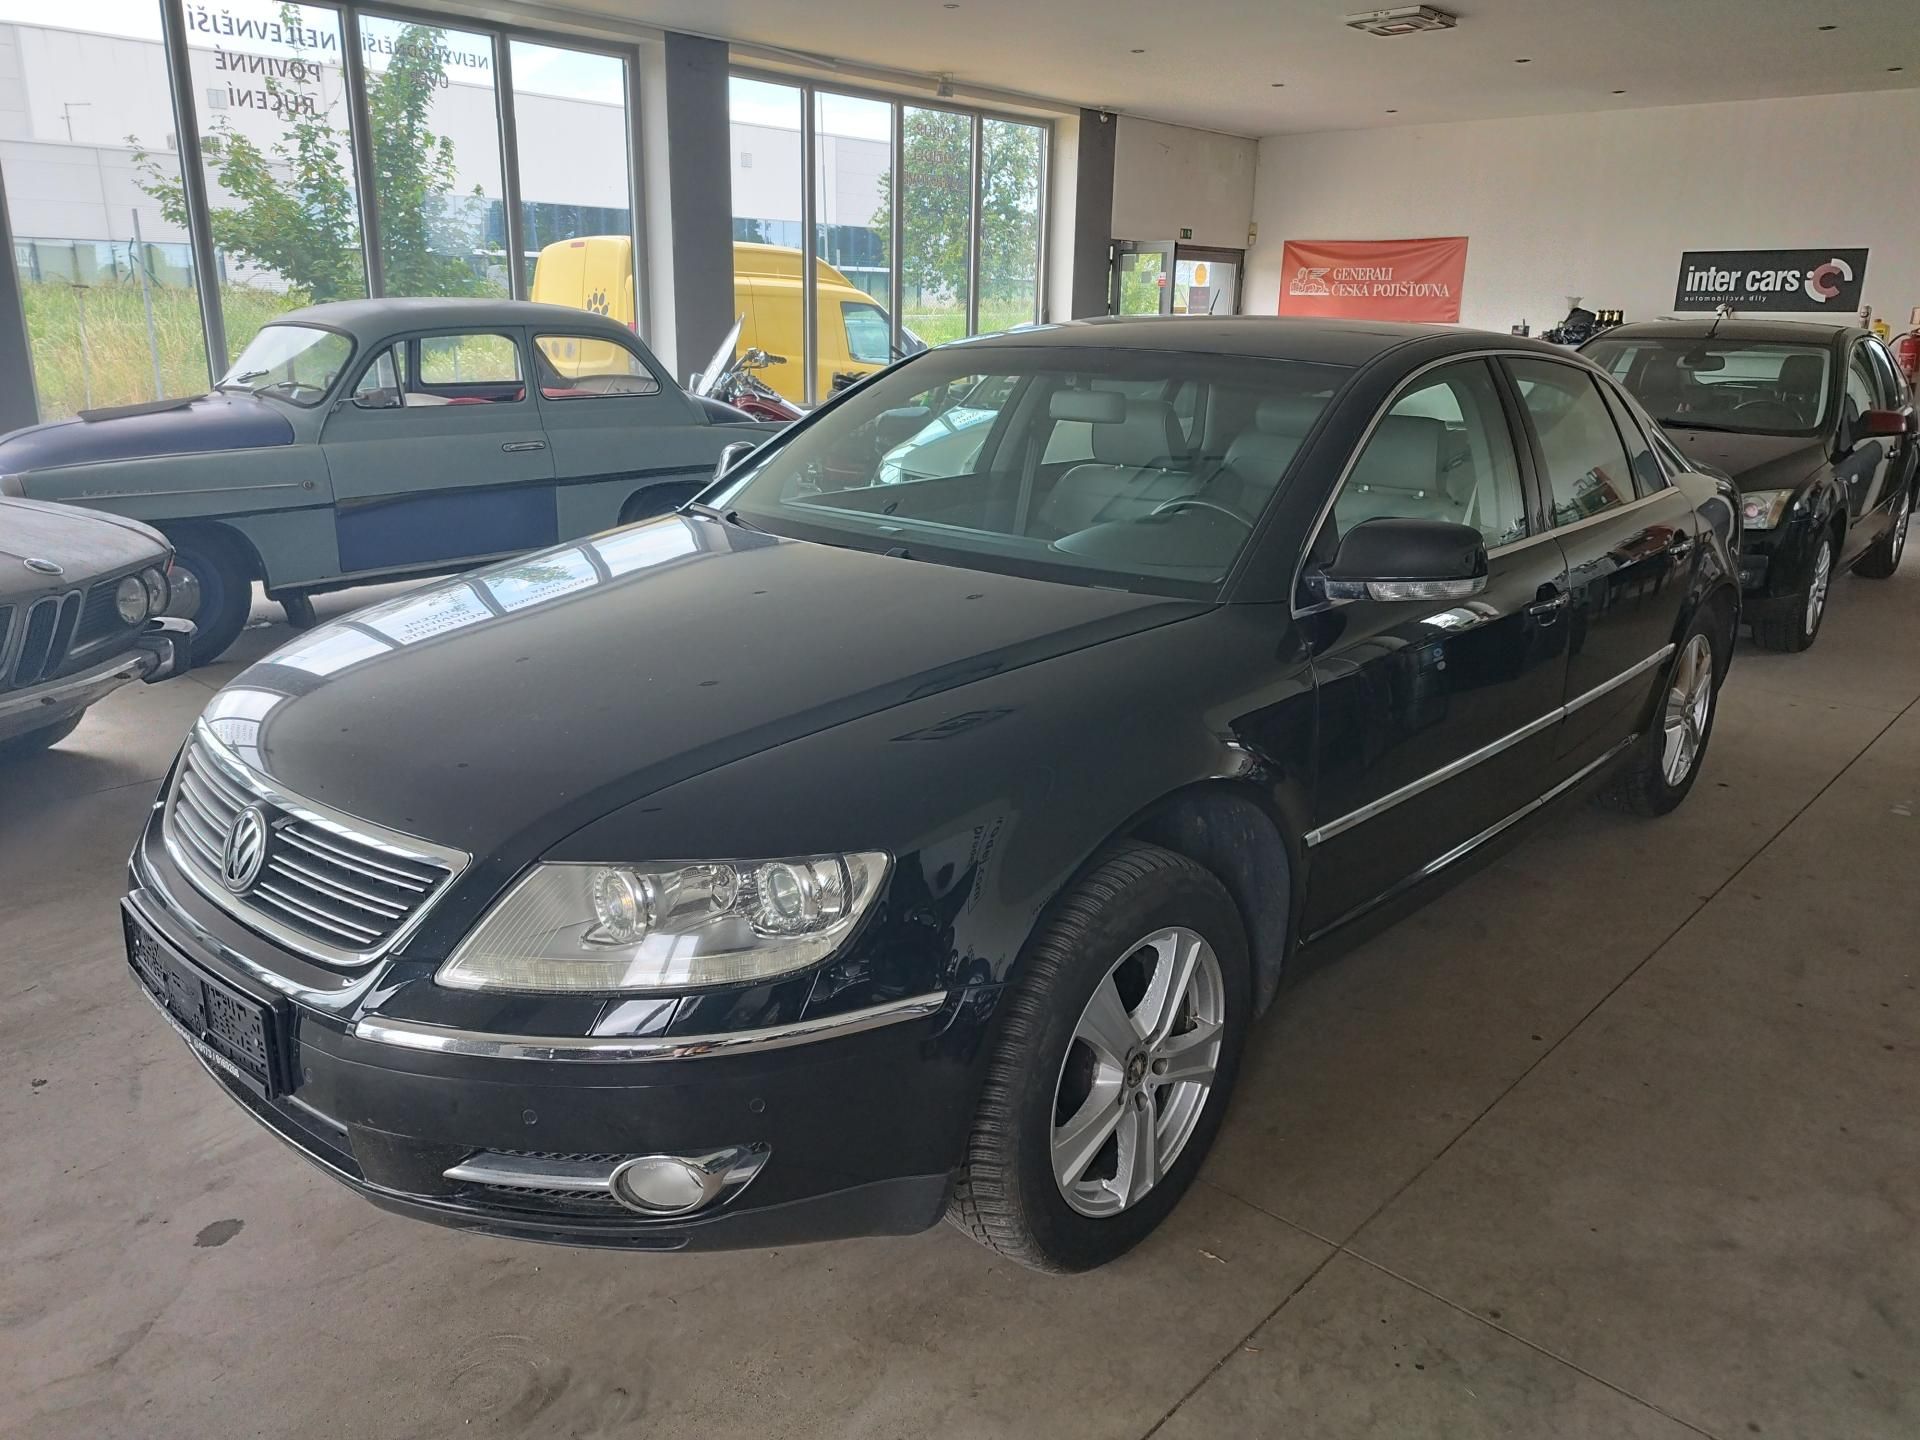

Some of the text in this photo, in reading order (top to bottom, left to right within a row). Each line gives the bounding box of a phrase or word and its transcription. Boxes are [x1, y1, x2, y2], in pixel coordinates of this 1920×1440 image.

[1333, 267, 1393, 281] GENERALI
[1685, 266, 1801, 292] inter cars
[1331, 280, 1450, 297] ČESKÁ POJIŠŤOVNA
